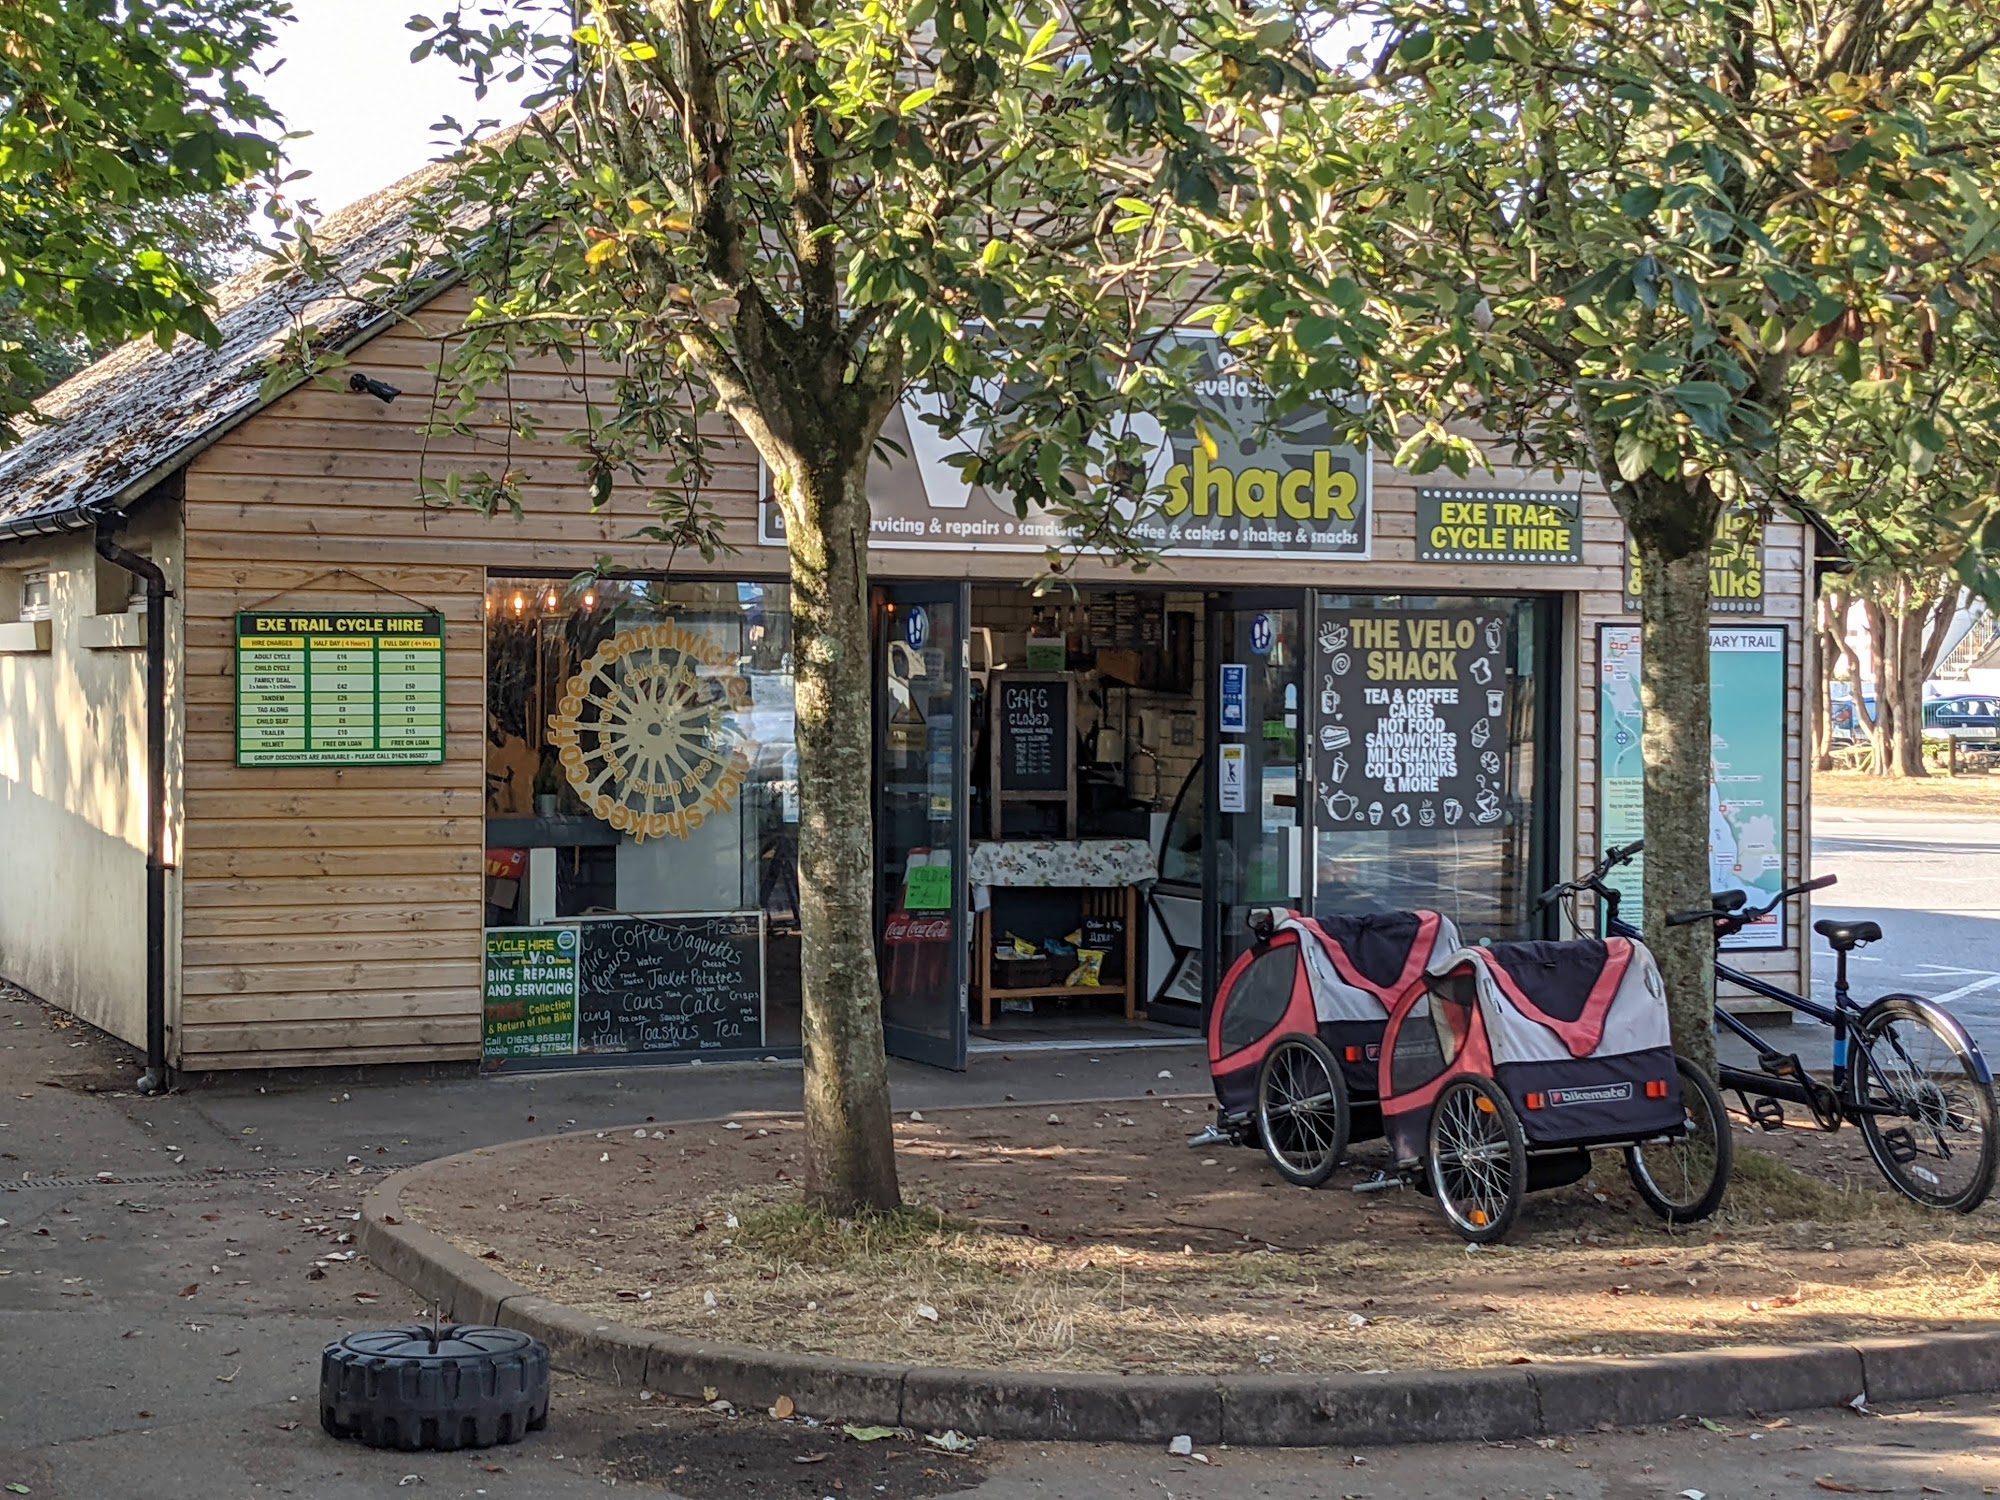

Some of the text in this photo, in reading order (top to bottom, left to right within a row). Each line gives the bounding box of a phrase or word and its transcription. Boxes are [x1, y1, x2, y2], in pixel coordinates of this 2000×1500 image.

[1164, 447, 1357, 520] shack
[1441, 503, 1561, 526] EXE TRAIL
[868, 517, 925, 535] rvicing
[930, 518, 943, 533] &
[946, 519, 1000, 537] repairs
[1169, 527, 1182, 540] &
[1185, 526, 1226, 541] cakes
[1243, 527, 1292, 543] shakes
[1296, 529, 1308, 543] &
[1311, 529, 1359, 544] snacks
[1430, 526, 1571, 550] CYCLE HIRE
[256, 618, 424, 631] EXE TRAIL CYCLE HIRE
[1350, 618, 1475, 649] THE VELO
[1741, 636, 1776, 648] TRAIL
[1366, 651, 1458, 681] SHACK
[623, 662, 671, 688] cakes
[1364, 688, 1459, 704] TEA & COFFEE
[1389, 704, 1435, 719] CAKES
[547, 675, 591, 785] coffee
[1378, 718, 1447, 733] HOT FOOD
[1365, 733, 1457, 749] SANDWICHES
[1367, 748, 1456, 763] MILKSHAKES
[1365, 762, 1458, 778] COLD DRINKS
[631, 758, 712, 801] cold drinks
[1383, 777, 1440, 792] & MORE
[593, 794, 705, 845] shakes
[707, 920, 752, 936] Pizza
[487, 939, 555, 951] CYCLE HIRE
[612, 924, 670, 950] Coffee
[667, 925, 742, 964] Baguettes
[636, 955, 663, 967] Water
[487, 967, 574, 981] BIKE REPAIRS
[647, 968, 690, 990] Jacket
[487, 984, 512, 997] AND
[515, 983, 573, 996] SERVICING
[729, 990, 759, 1001] Crisps
[529, 1000, 571, 1014] Collection
[623, 993, 664, 1011] Cans
[680, 994, 726, 1016] Cake
[488, 1012, 571, 1034] & Return of the Bike
[635, 1019, 699, 1041] Toasties
[713, 1018, 742, 1038] Tea
[506, 1035, 534, 1044] 01626
[536, 1033, 572, 1043] 865827
[1561, 1086, 1627, 1102] bikemate
